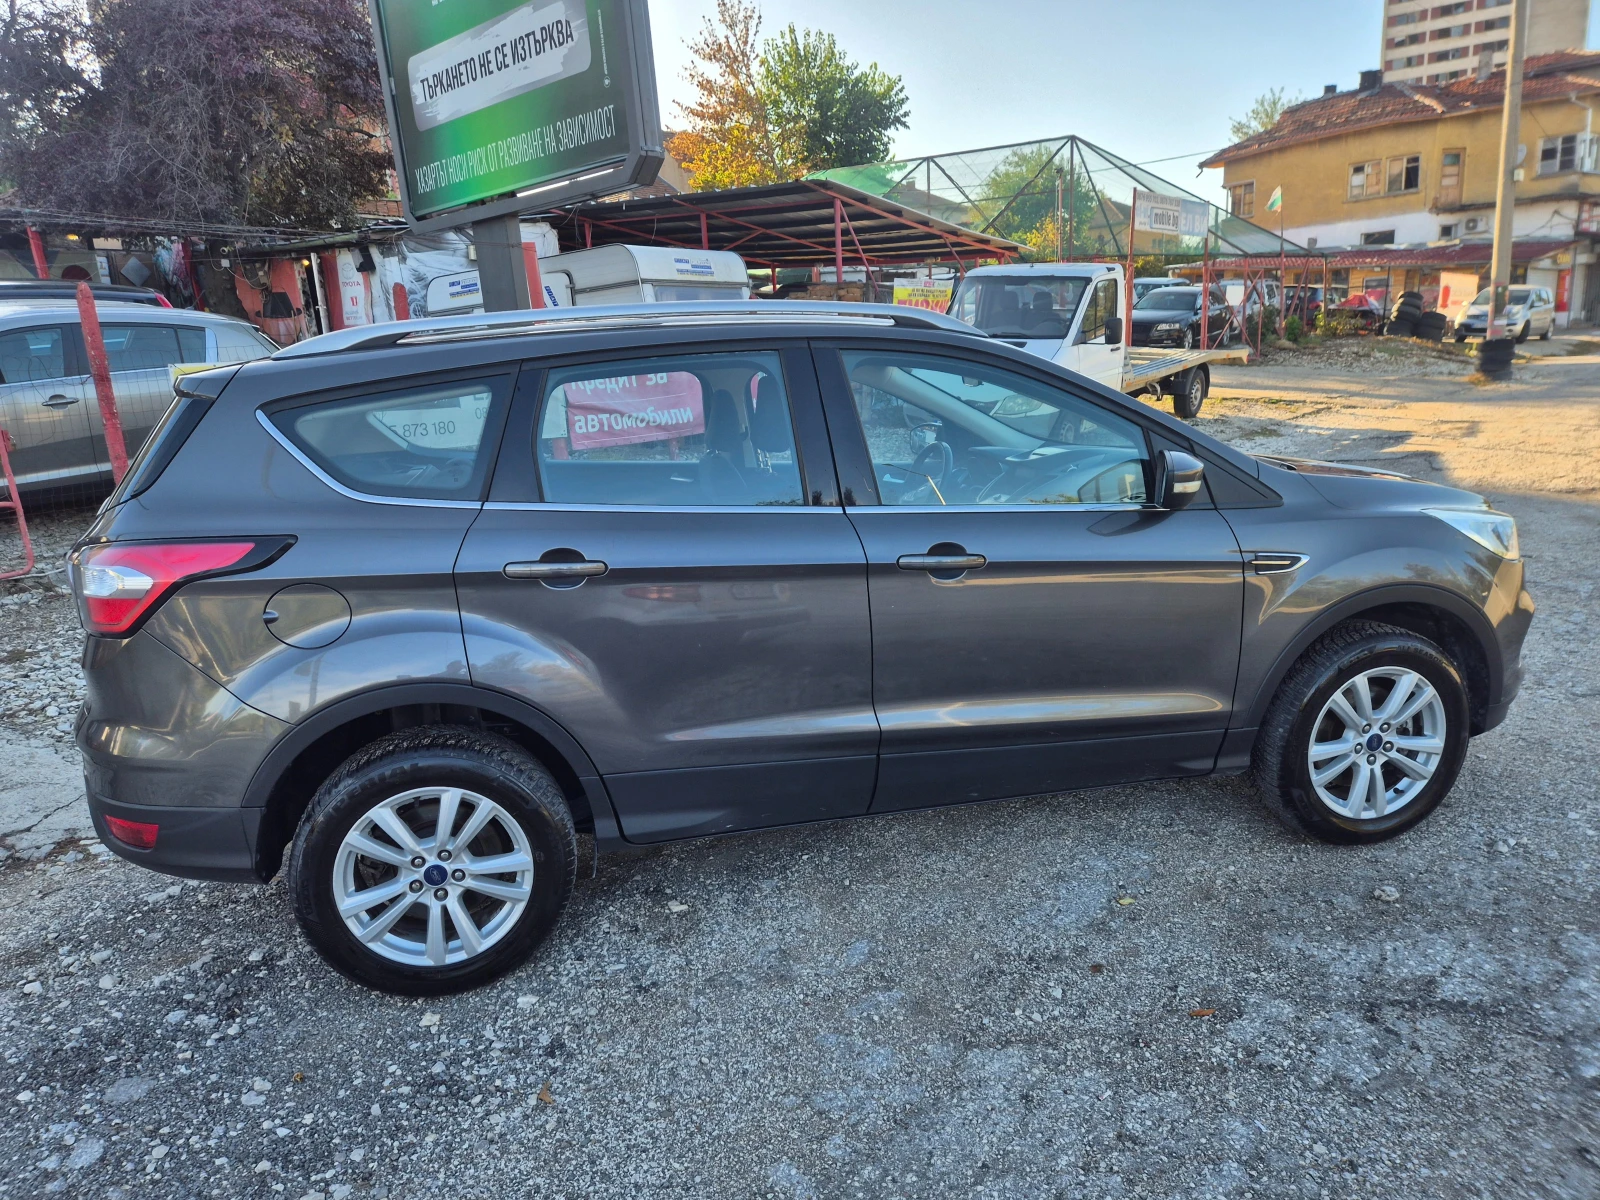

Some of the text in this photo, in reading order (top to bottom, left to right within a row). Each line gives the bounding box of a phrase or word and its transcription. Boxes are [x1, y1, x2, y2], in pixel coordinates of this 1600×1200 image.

[420, 57, 477, 102] ТЪРКАНЕТО
[478, 50, 494, 79] НЕ
[494, 43, 510, 72] СЕ
[510, 19, 574, 66] ИЗТЪРКВА
[415, 104, 616, 195] ХАЗАРТЪТ НОСИ РИСК ОТ РАЗВИВАНЕ НА ЗАВИСИМОСТ
[402, 422, 429, 438] 873
[432, 420, 456, 435] 180
[574, 406, 694, 434] автомобили
